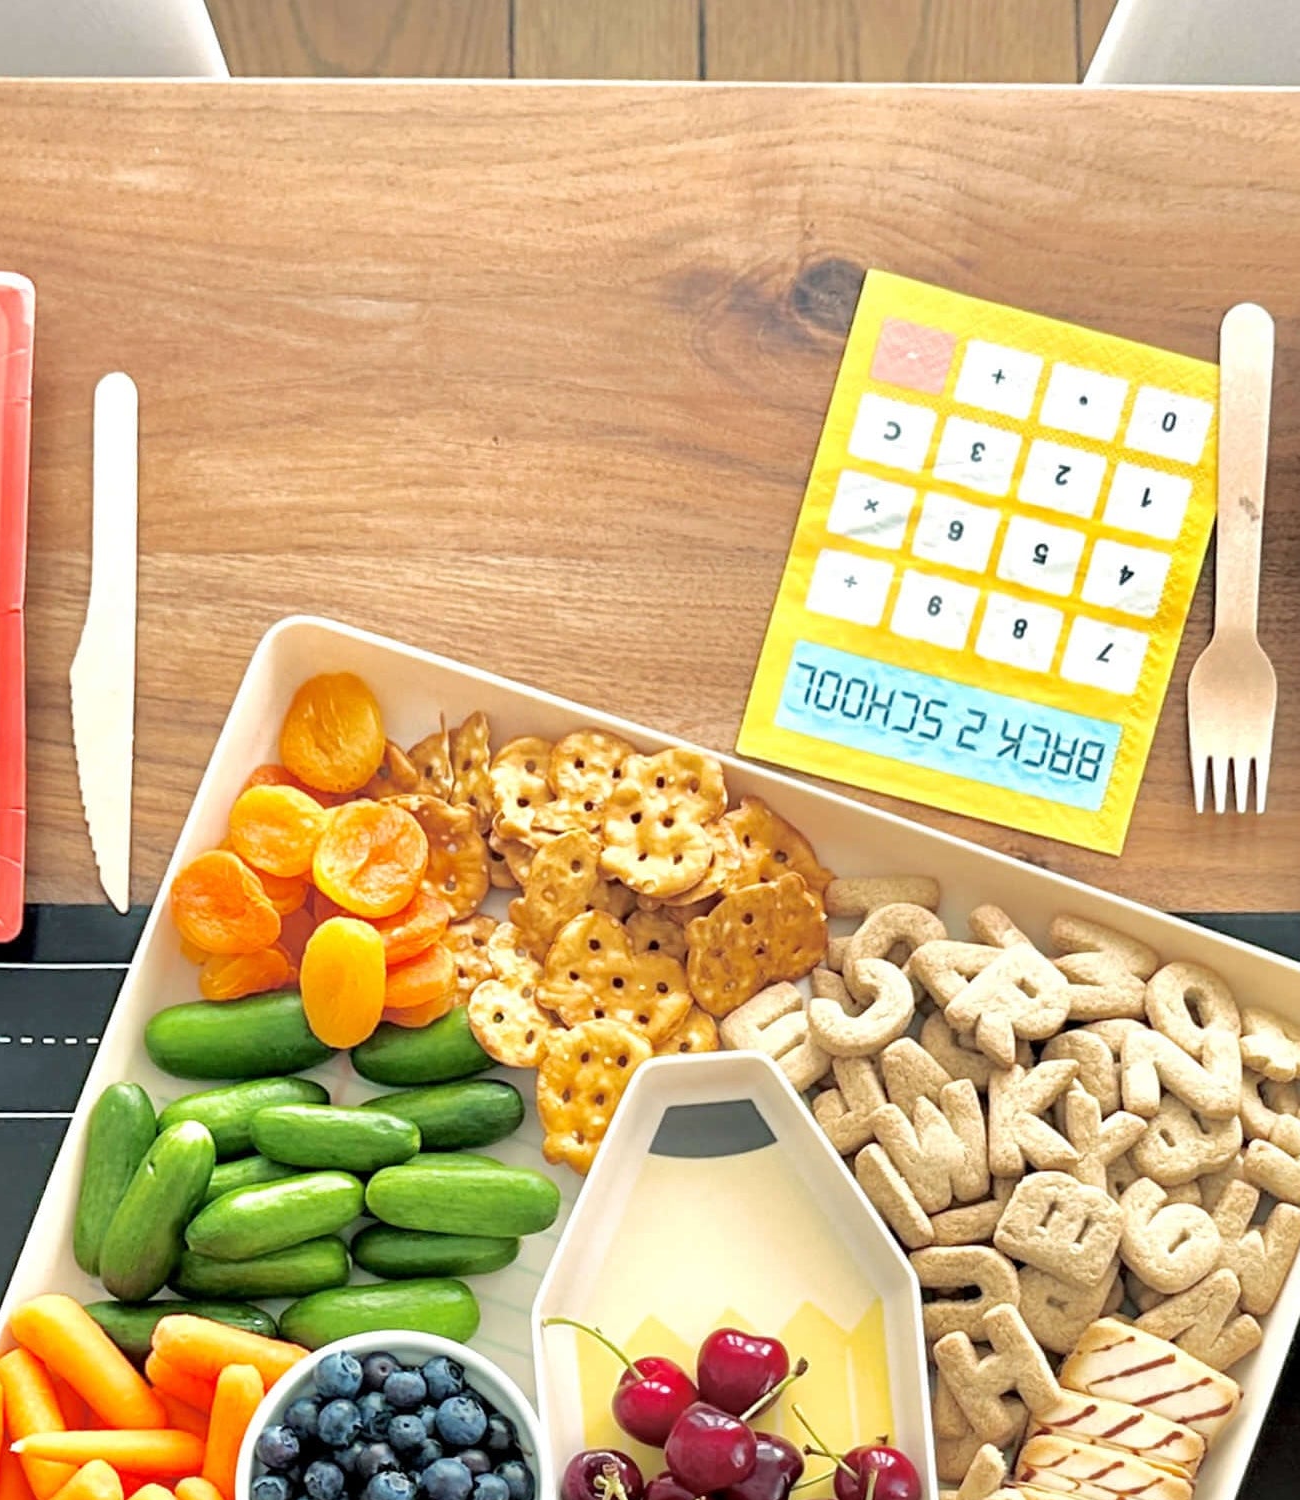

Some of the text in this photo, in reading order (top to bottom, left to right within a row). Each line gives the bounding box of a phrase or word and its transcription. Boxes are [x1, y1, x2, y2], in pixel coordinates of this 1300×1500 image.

[1162, 412, 1177, 432] 0
[883, 421, 1152, 508] 1 2 3 C
[948, 520, 964, 542] 6
[1032, 543, 1049, 565] 5
[1119, 565, 1135, 586] 4
[927, 595, 943, 616] 9
[1013, 618, 1028, 639] 8
[1097, 643, 1114, 663] 7
[796, 661, 1106, 783] BACK 2 SCHOOL
